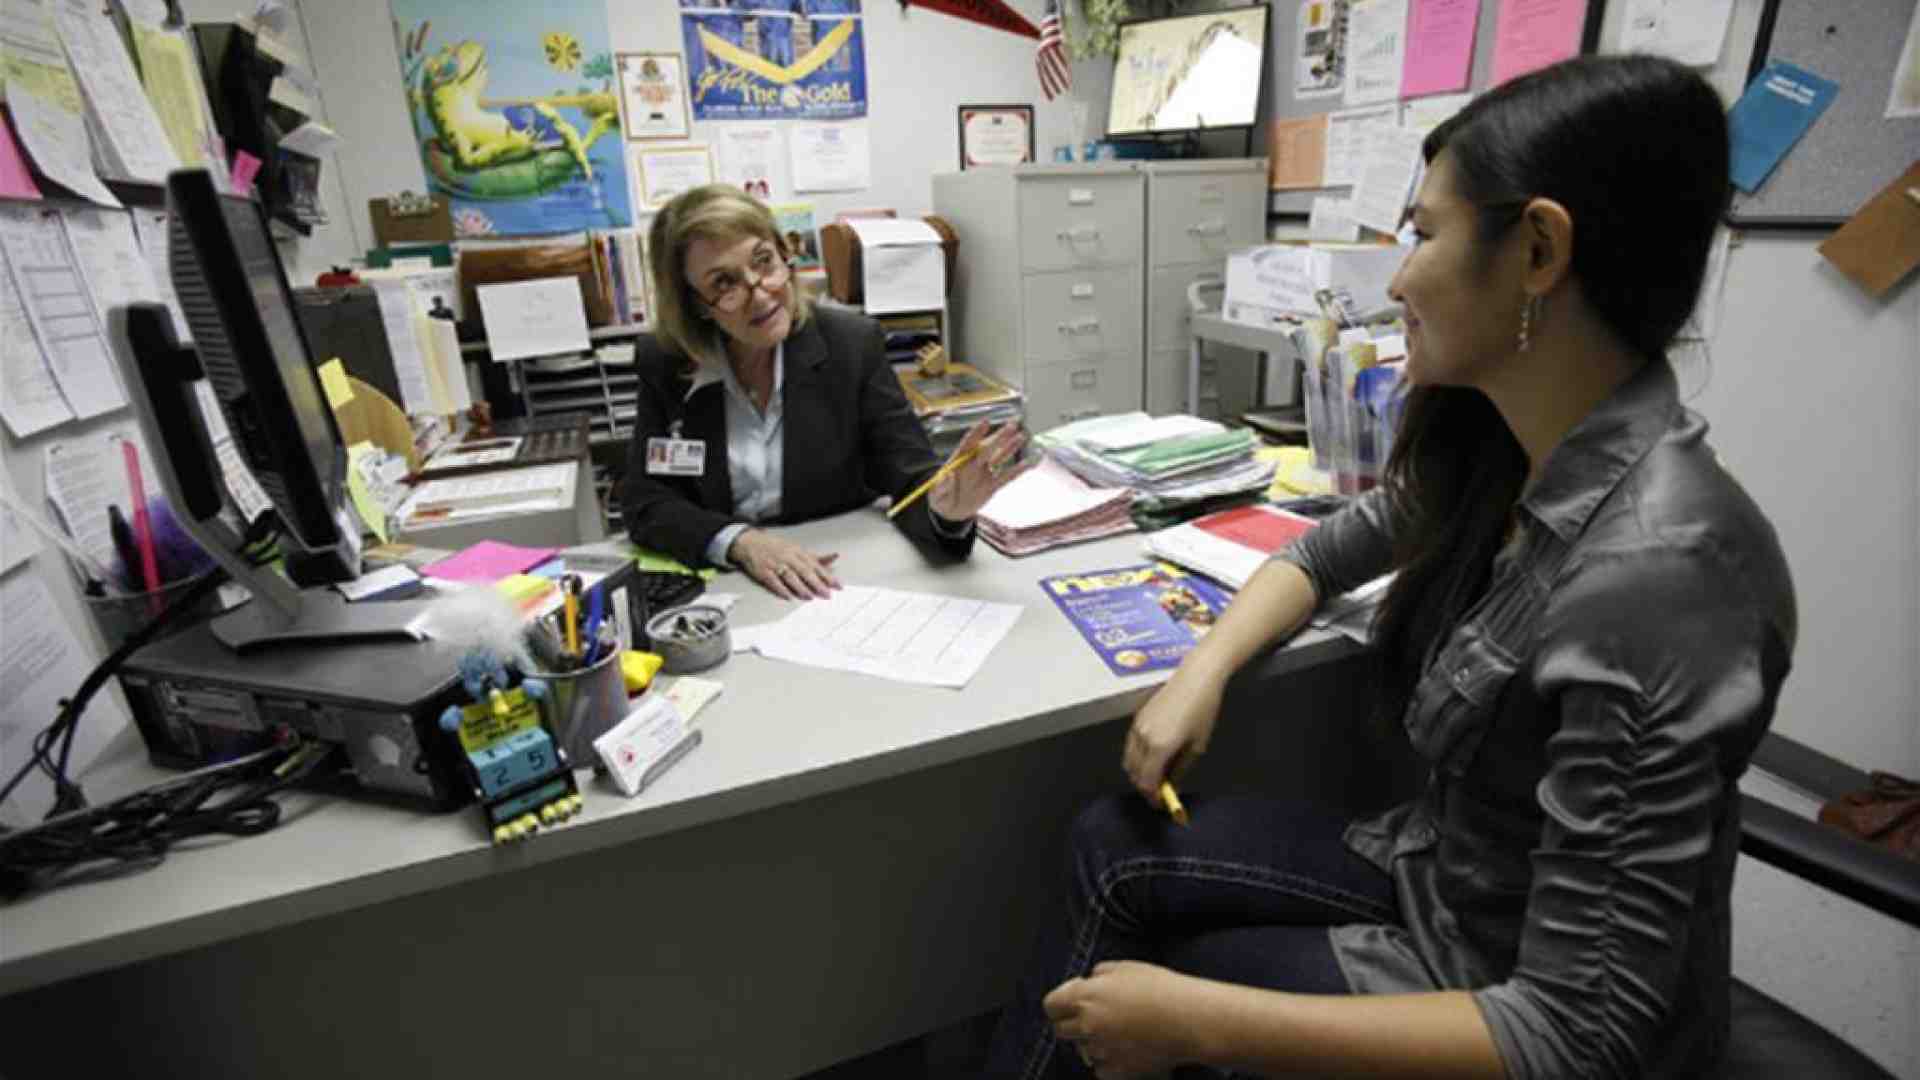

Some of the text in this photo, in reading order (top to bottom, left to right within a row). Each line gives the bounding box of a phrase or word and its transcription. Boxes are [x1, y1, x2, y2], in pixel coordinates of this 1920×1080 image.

[742, 82, 850, 104] The Gold
[528, 751, 545, 771] 5
